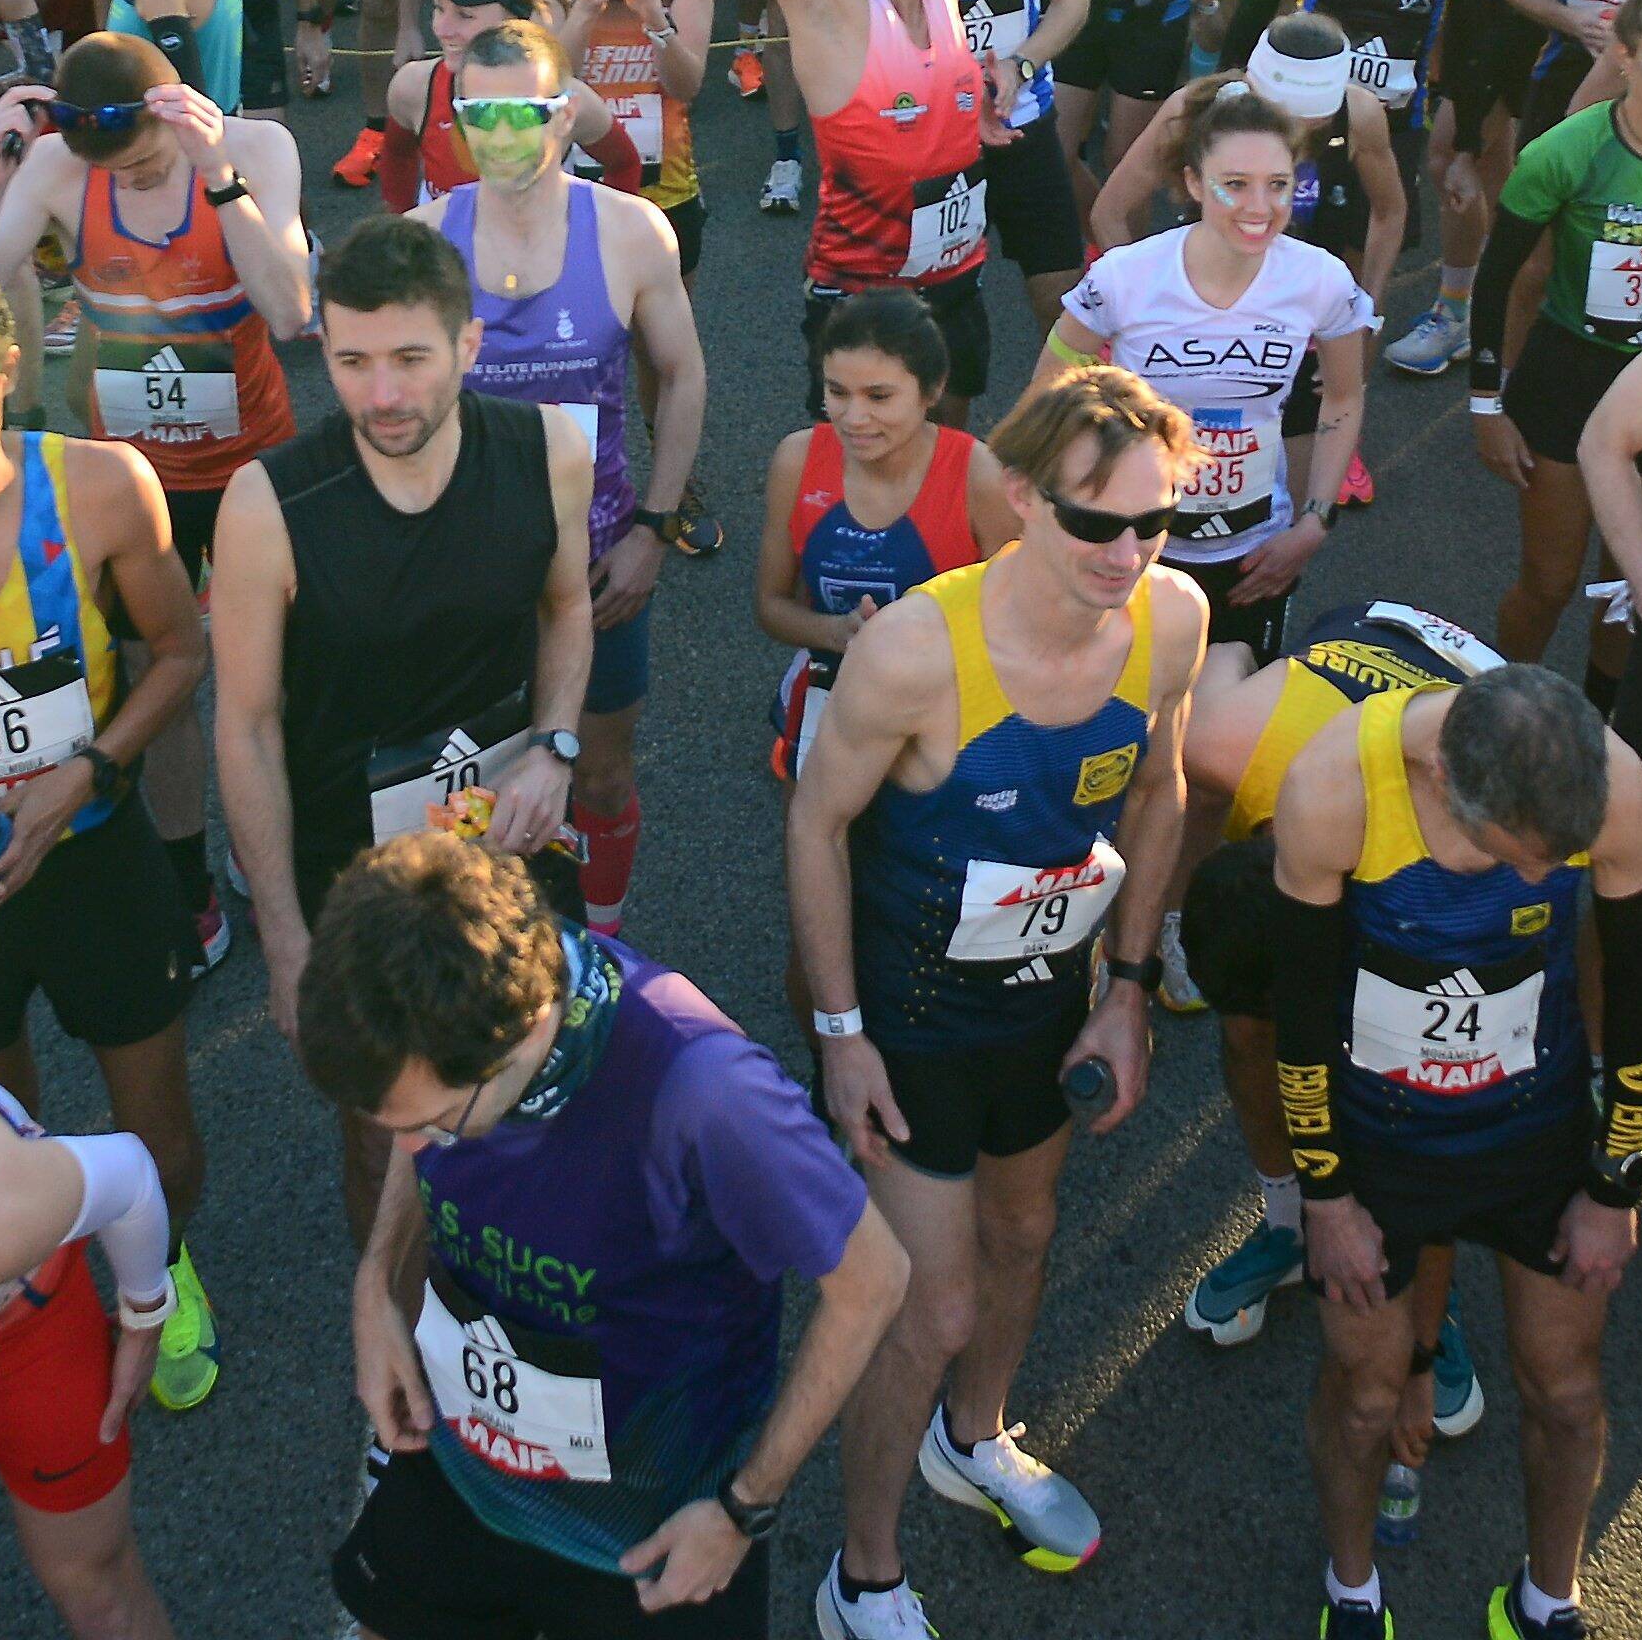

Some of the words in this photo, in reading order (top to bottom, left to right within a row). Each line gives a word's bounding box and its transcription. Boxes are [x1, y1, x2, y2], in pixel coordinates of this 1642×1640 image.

[1349, 56, 1390, 89] 100
[604, 97, 638, 115] AIF
[937, 195, 971, 237] 102
[1145, 338, 1292, 369] ASAB
[144, 376, 187, 410] 54
[1183, 459, 1245, 497] 335
[1019, 865, 1105, 899] MAIF
[1019, 892, 1069, 939] 79
[1421, 1000, 1482, 1043] 24
[1405, 1057, 1500, 1090] MAIF
[480, 1224, 598, 1298] SUCY
[461, 1345, 519, 1415] 68
[459, 1414, 556, 1473] MAIF
